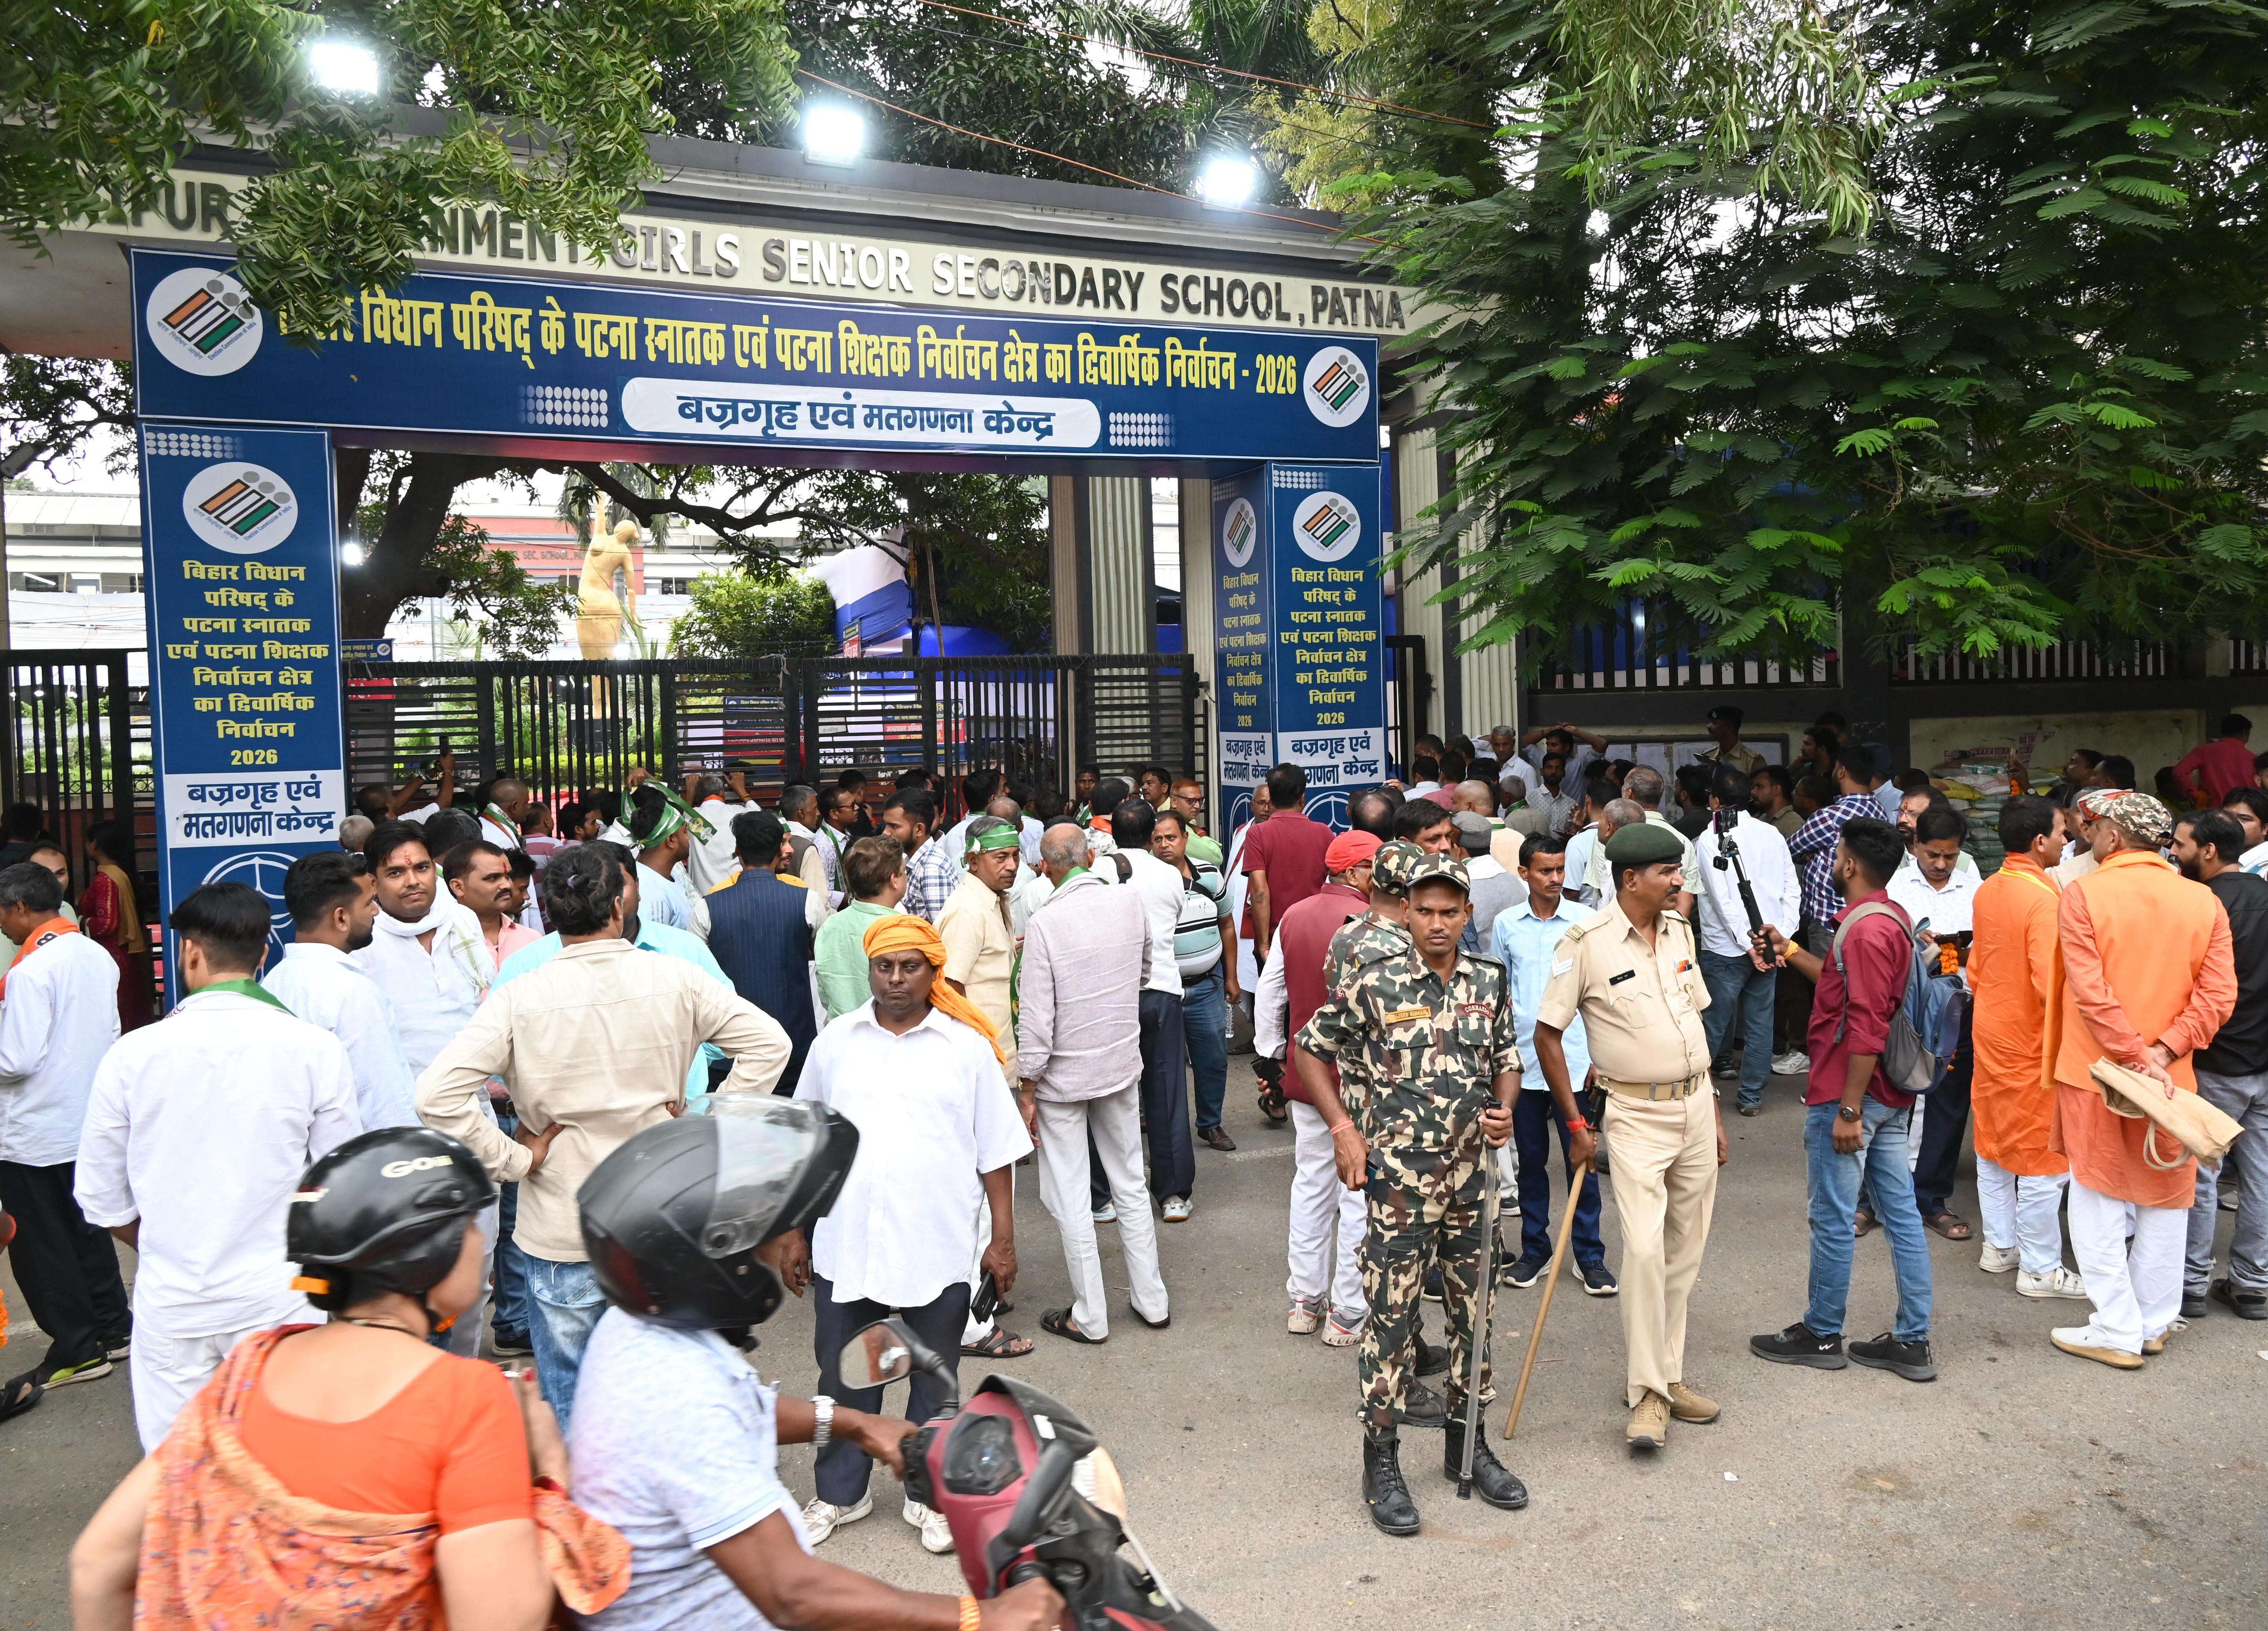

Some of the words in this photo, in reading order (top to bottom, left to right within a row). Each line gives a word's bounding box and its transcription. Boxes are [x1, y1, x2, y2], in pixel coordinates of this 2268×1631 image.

[611, 222, 740, 277] GIRLS
[763, 238, 913, 292] SENIOR
[932, 254, 1145, 311] SECONDARY
[1311, 285, 1405, 329] PATNA
[208, 348, 223, 360] Election
[221, 332, 243, 349] Commission
[247, 322, 257, 330] India
[361, 283, 444, 347] विधान
[451, 292, 534, 369] परिषद्
[540, 296, 566, 354] के
[574, 313, 638, 359] पटना
[644, 318, 726, 365] स्नातक
[733, 315, 769, 368] एवं
[775, 328, 833, 372] पटना
[839, 321, 911, 376] शिक्षक
[918, 325, 998, 380] निर्वाचन
[1005, 330, 1039, 382] क्षेत्र
[1045, 344, 1072, 383] का
[1078, 333, 1160, 385] द्विवार्षिक
[1166, 337, 1236, 389] निर्वाचन
[1257, 354, 1296, 394] 2026
[677, 395, 801, 436] बज्रगृह
[807, 391, 856, 430] एवं
[862, 405, 973, 433] मतगणना
[983, 400, 1056, 441] केन्द्र
[183, 560, 239, 580] बिहार
[244, 561, 306, 581] विधान
[1291, 567, 1325, 582] बिहार
[1327, 567, 1364, 582] विधान
[1223, 575, 1239, 589] बिहार
[1241, 572, 1259, 587] विधान
[205, 587, 269, 611] परिषद्
[275, 588, 294, 607] के
[1229, 594, 1248, 609] परिषद्
[1249, 591, 1256, 605] के
[1303, 588, 1341, 606] परिषद्
[1344, 588, 1356, 602] के
[184, 617, 236, 633] पटना
[243, 618, 311, 633] स्नातक
[1223, 616, 1239, 628] पटना
[1240, 614, 1261, 627] स्नातक
[1291, 611, 1322, 623] पटना
[1326, 610, 1366, 623] स्नातक
[1219, 635, 1228, 648] एवं
[1230, 635, 1244, 647] पटना
[1246, 631, 1267, 646] शिक्षक
[1281, 629, 1299, 643] एवं
[1302, 631, 1334, 644] पटना
[1337, 627, 1377, 643] शिक्षक
[166, 640, 199, 659] एवं
[205, 644, 257, 659] पटना
[263, 640, 329, 659] शिक्षक
[1295, 649, 1343, 664] निर्वाचन
[1346, 649, 1367, 663] क्षेत्र
[1226, 652, 1249, 668] निर्वाचन
[1251, 651, 1262, 666] क्षेत्र
[194, 666, 273, 686] निर्वाचन
[279, 667, 313, 686] क्षेत्र
[1227, 675, 1235, 688] का
[1236, 672, 1263, 688] द्विवार्षिक
[1296, 672, 1314, 685] का
[1316, 668, 1368, 684] द्विवार्षिक
[195, 697, 223, 712] का
[228, 691, 315, 712] द्विवार्षिक
[1233, 693, 1257, 708] निर्वाचन
[1309, 689, 1355, 705] निर्वाचन
[1237, 714, 1252, 727] 2026
[1317, 712, 1345, 725] 2026
[217, 718, 295, 738] निर्वाचन
[1254, 735, 1266, 756] एवं
[1291, 737, 1346, 759] बज्रगृह
[1348, 730, 1371, 752] एवं
[231, 749, 278, 765] 2026
[1224, 761, 1250, 782] मतगणना
[1343, 756, 1379, 778] केन्द्र
[187, 783, 280, 809] बज्रगृह
[284, 774, 322, 801] एवं
[184, 812, 273, 838] मतगणना
[275, 806, 335, 834] केन्द्र
[1465, 1005, 1489, 1015] COMMANDO
